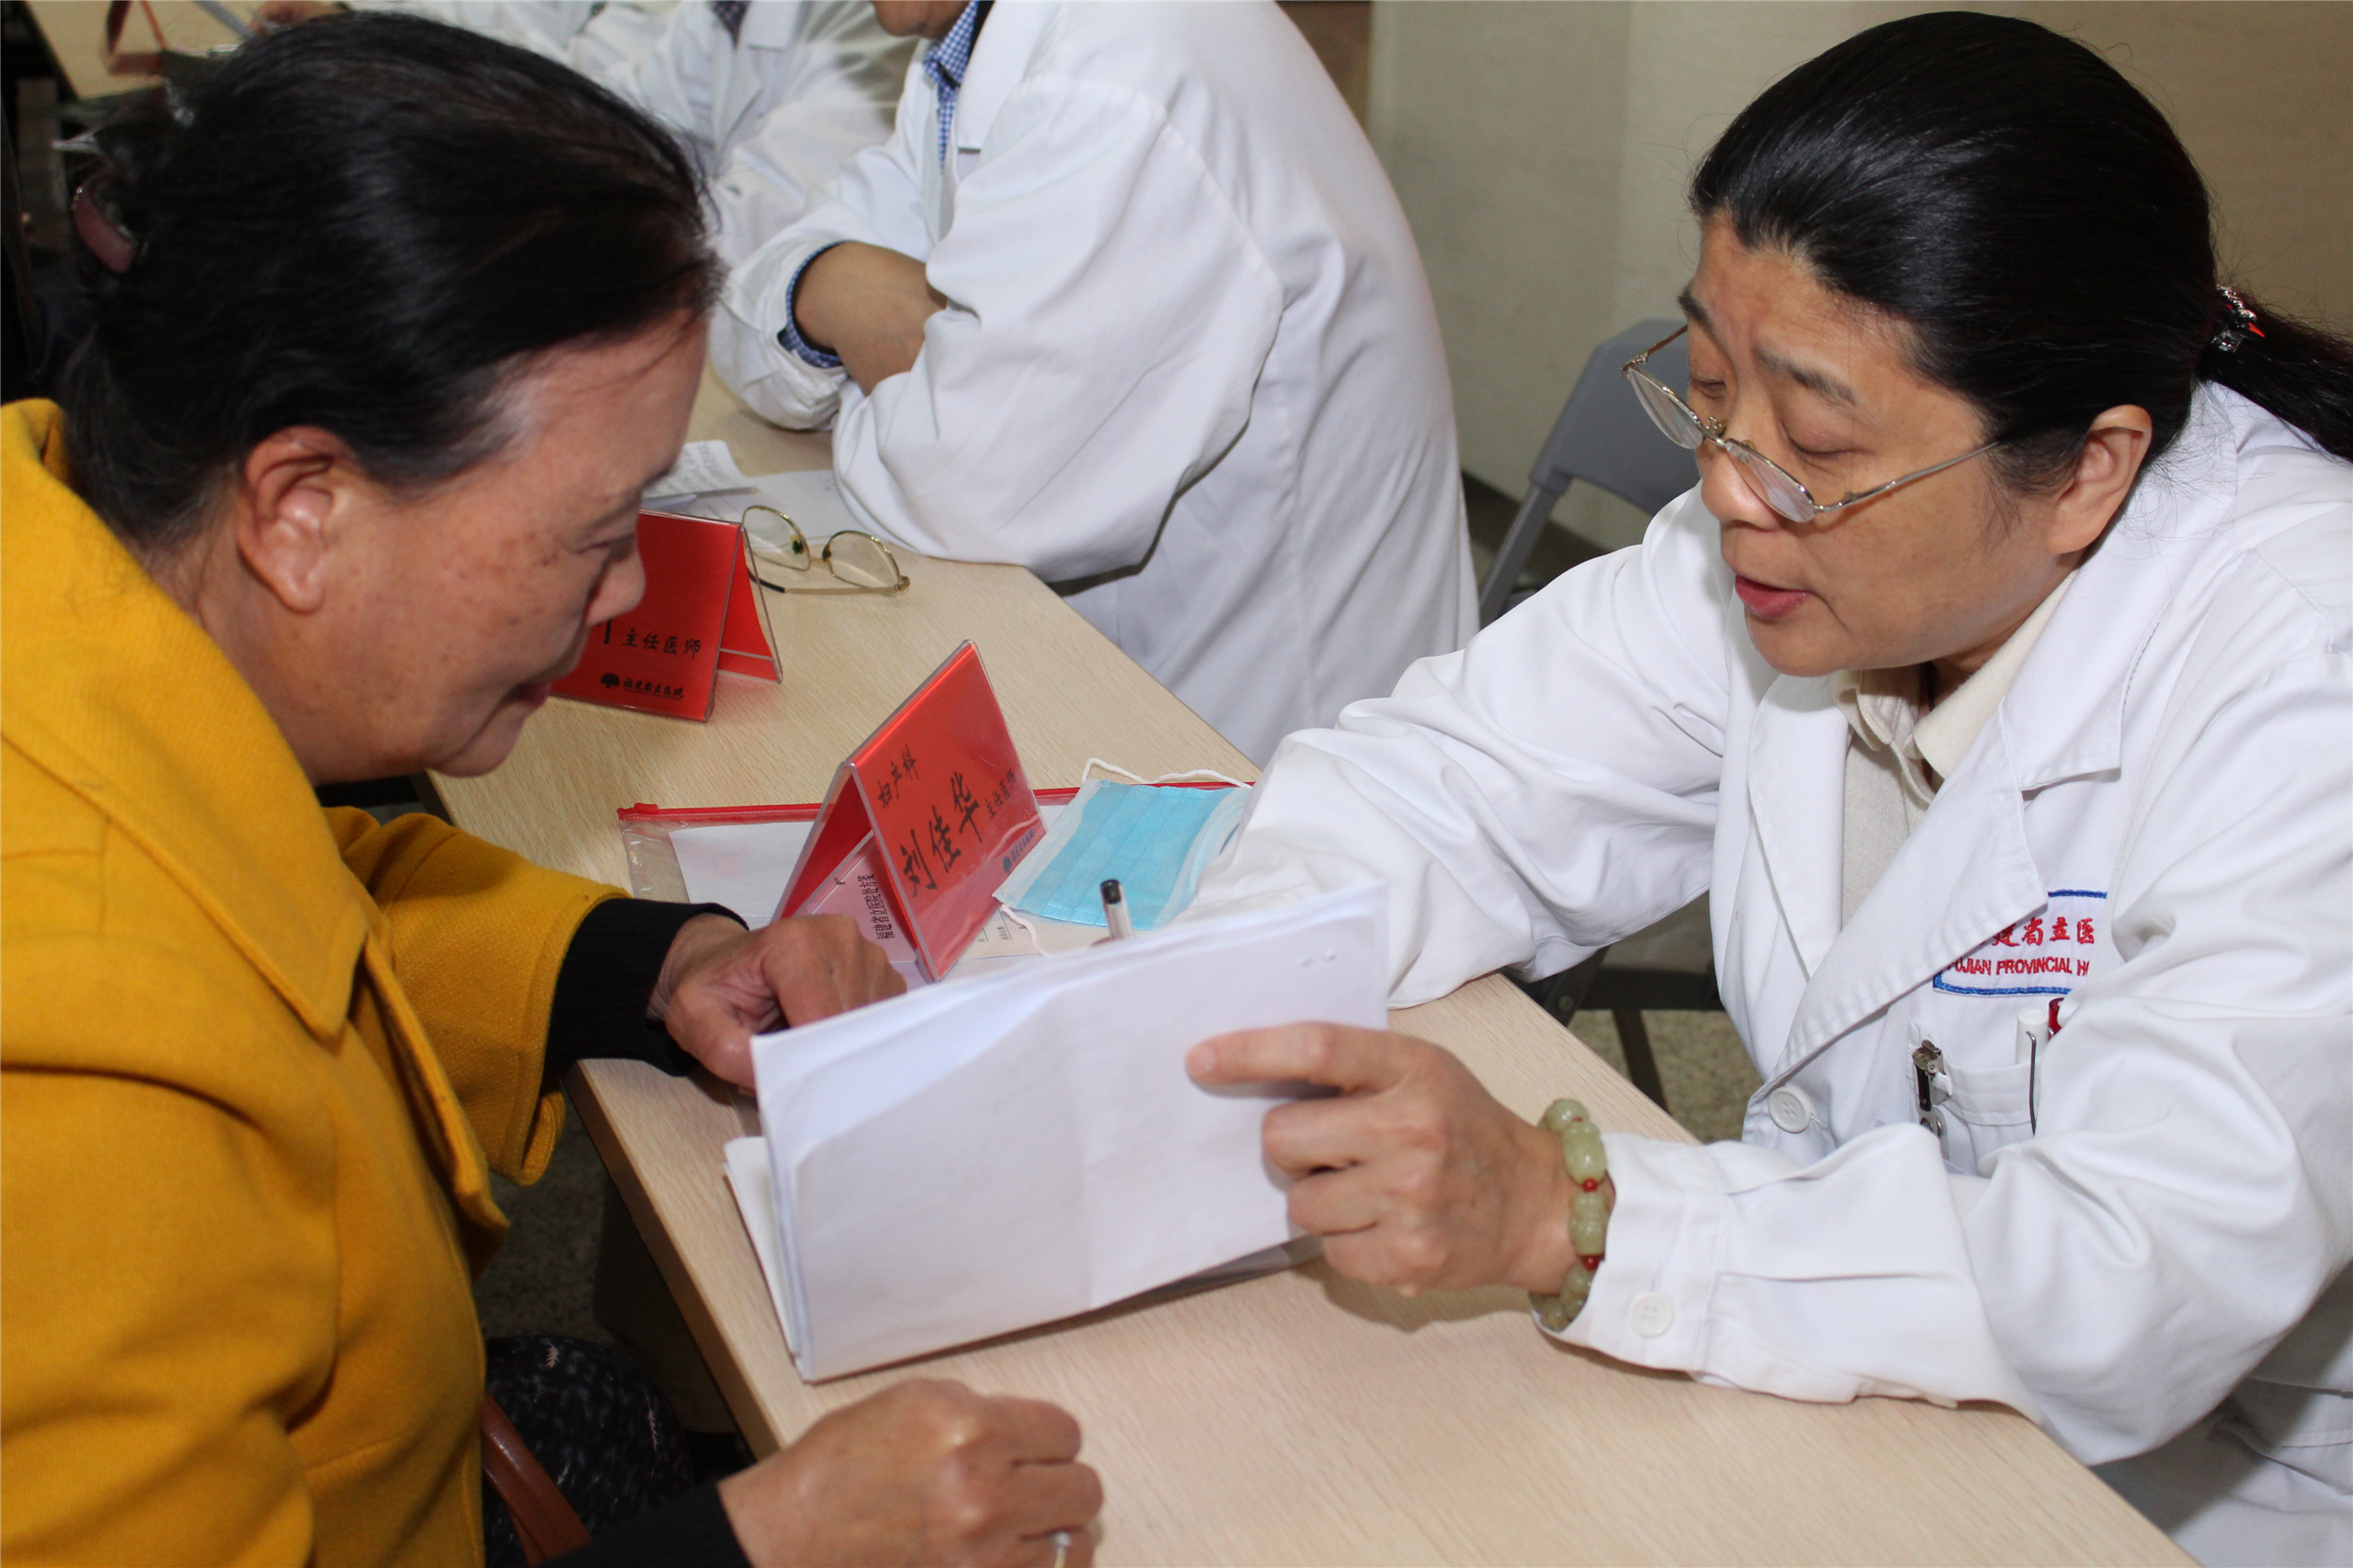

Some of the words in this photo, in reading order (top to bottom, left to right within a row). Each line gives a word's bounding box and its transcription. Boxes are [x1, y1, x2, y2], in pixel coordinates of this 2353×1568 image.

[621, 629, 701, 660] 主任医师
[877, 744, 920, 808] 妇产科
[900, 771, 981, 898] 刘佳华
[1979, 916, 2095, 947] 建省立医
[1996, 955, 2073, 976] PROVINCIAL
